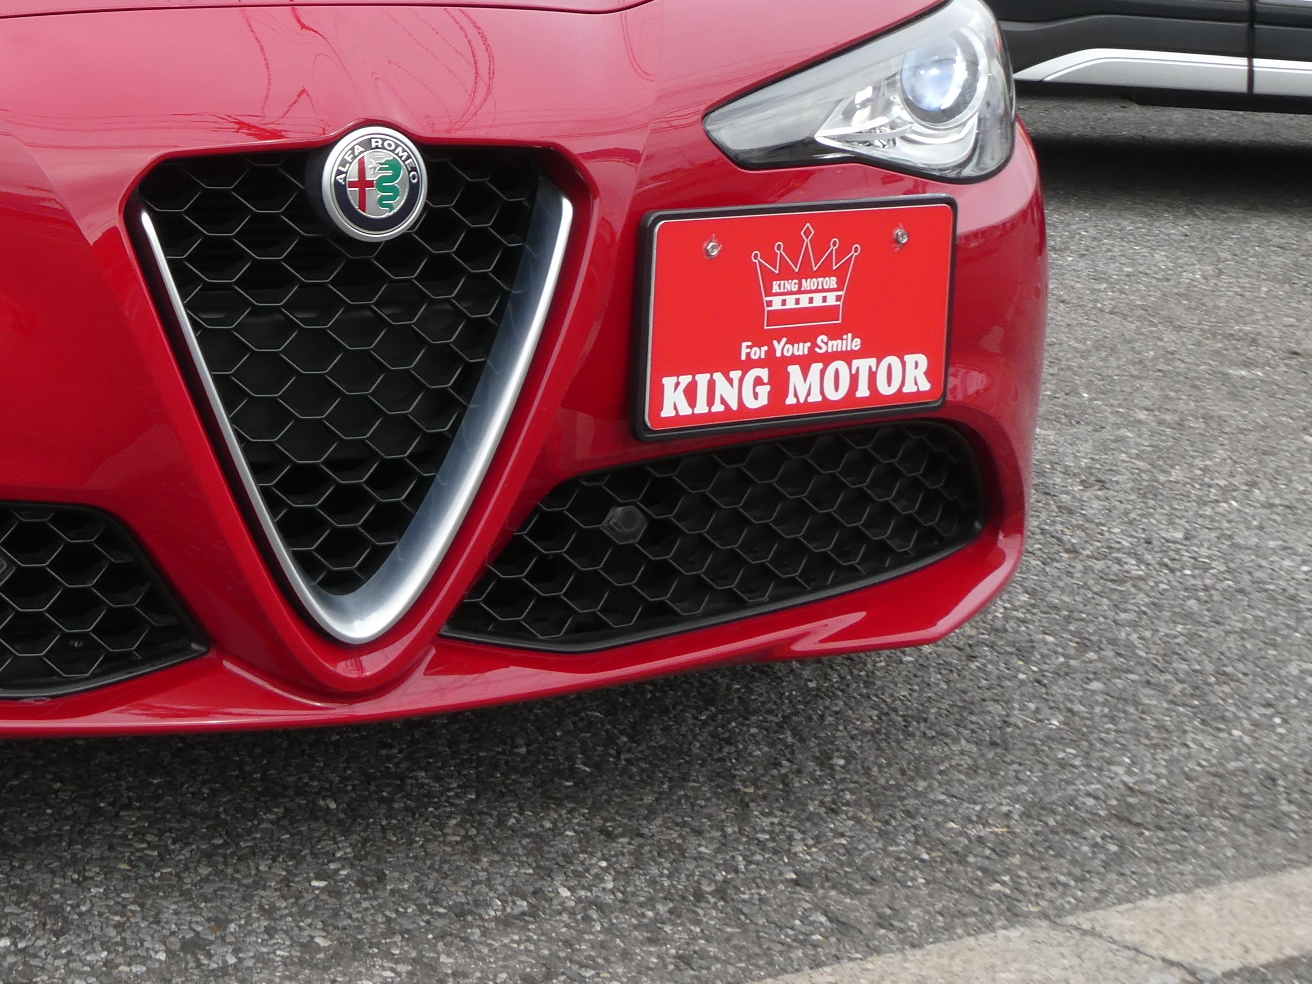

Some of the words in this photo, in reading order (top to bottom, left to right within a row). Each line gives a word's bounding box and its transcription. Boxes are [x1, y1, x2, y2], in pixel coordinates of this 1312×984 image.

[335, 144, 366, 185] ALFA
[370, 137, 419, 184] ROMEO
[771, 279, 799, 293] KING
[801, 276, 838, 291] MOTOR
[740, 341, 768, 361] For
[772, 336, 812, 358] Your
[814, 332, 862, 354] Smile
[659, 367, 771, 418] KING
[784, 352, 932, 405] MOTOR
